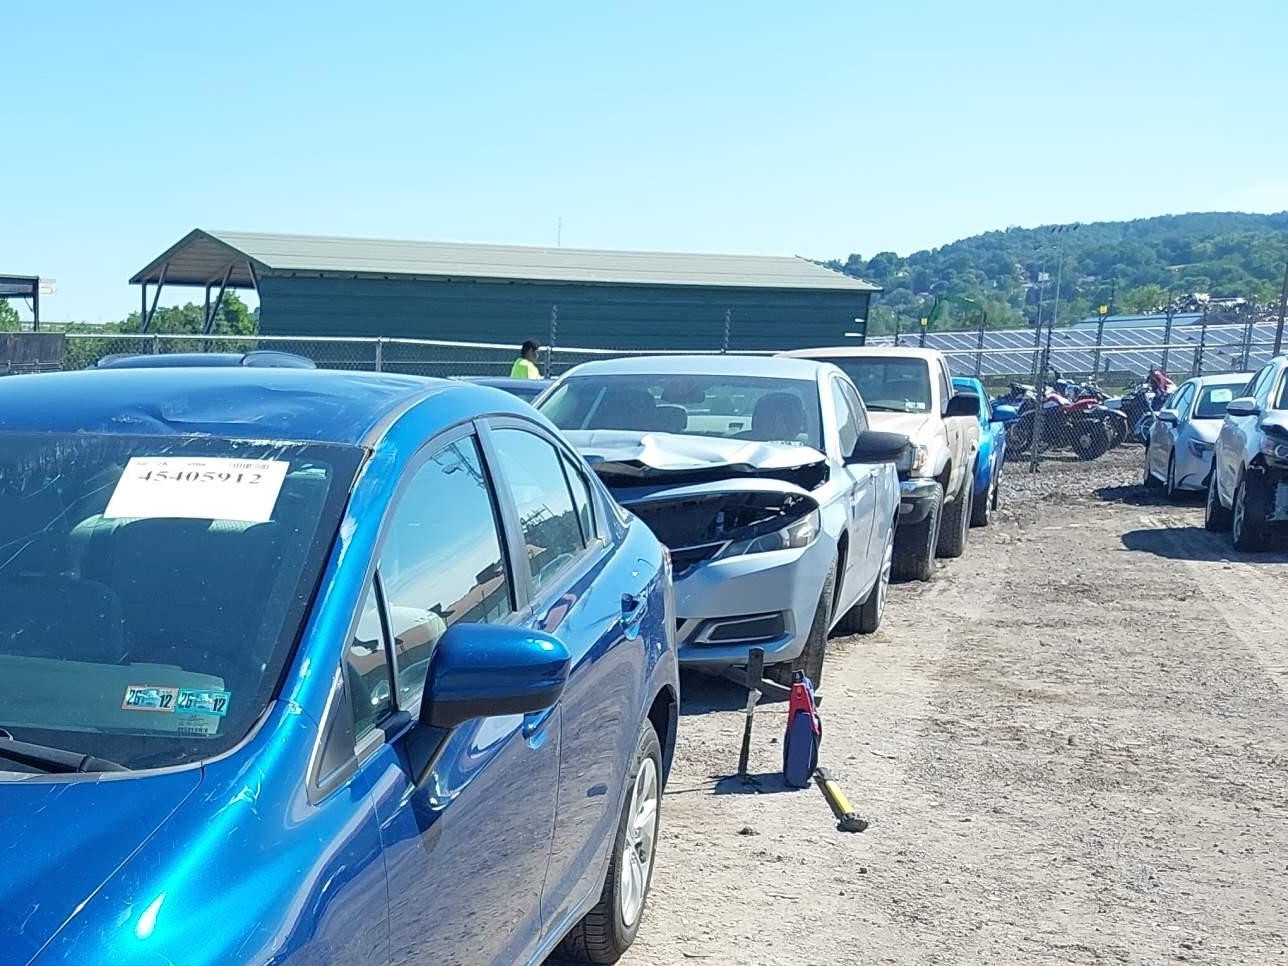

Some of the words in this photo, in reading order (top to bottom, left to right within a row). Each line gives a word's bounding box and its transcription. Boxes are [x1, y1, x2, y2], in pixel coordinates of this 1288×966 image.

[138, 470, 262, 484] 45405912
[159, 694, 173, 708] 12
[211, 698, 226, 712] 12
